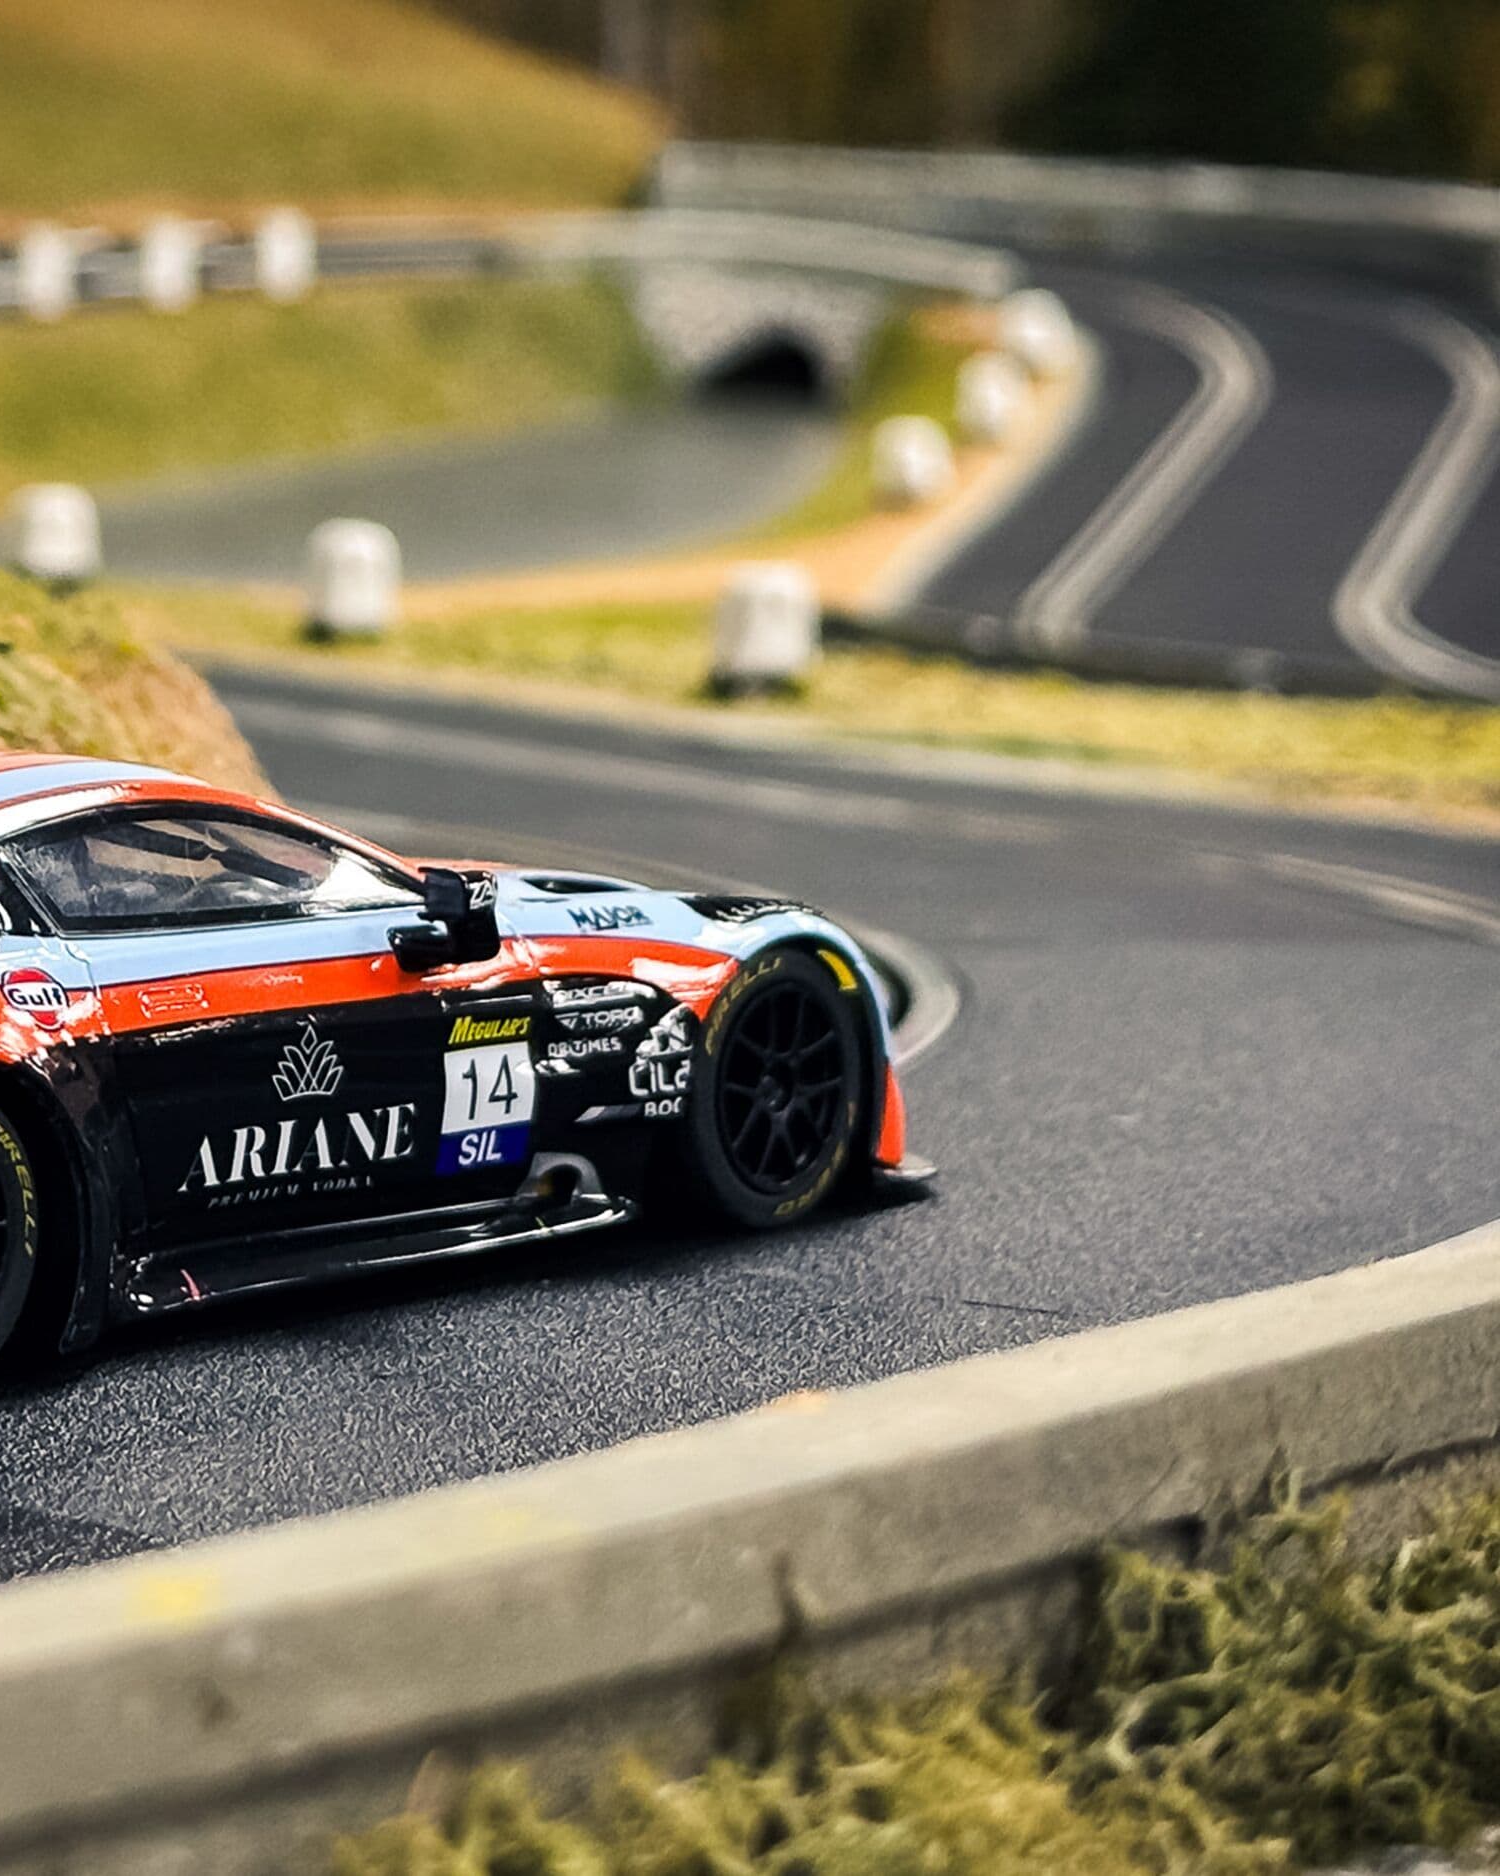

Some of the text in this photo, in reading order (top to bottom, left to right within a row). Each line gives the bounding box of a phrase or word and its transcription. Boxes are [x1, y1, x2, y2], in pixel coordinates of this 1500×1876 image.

[7, 986, 62, 1006] Gulf
[462, 1054, 518, 1120] 14
[177, 1102, 416, 1193] ARIANE
[458, 1130, 502, 1166] SIL
